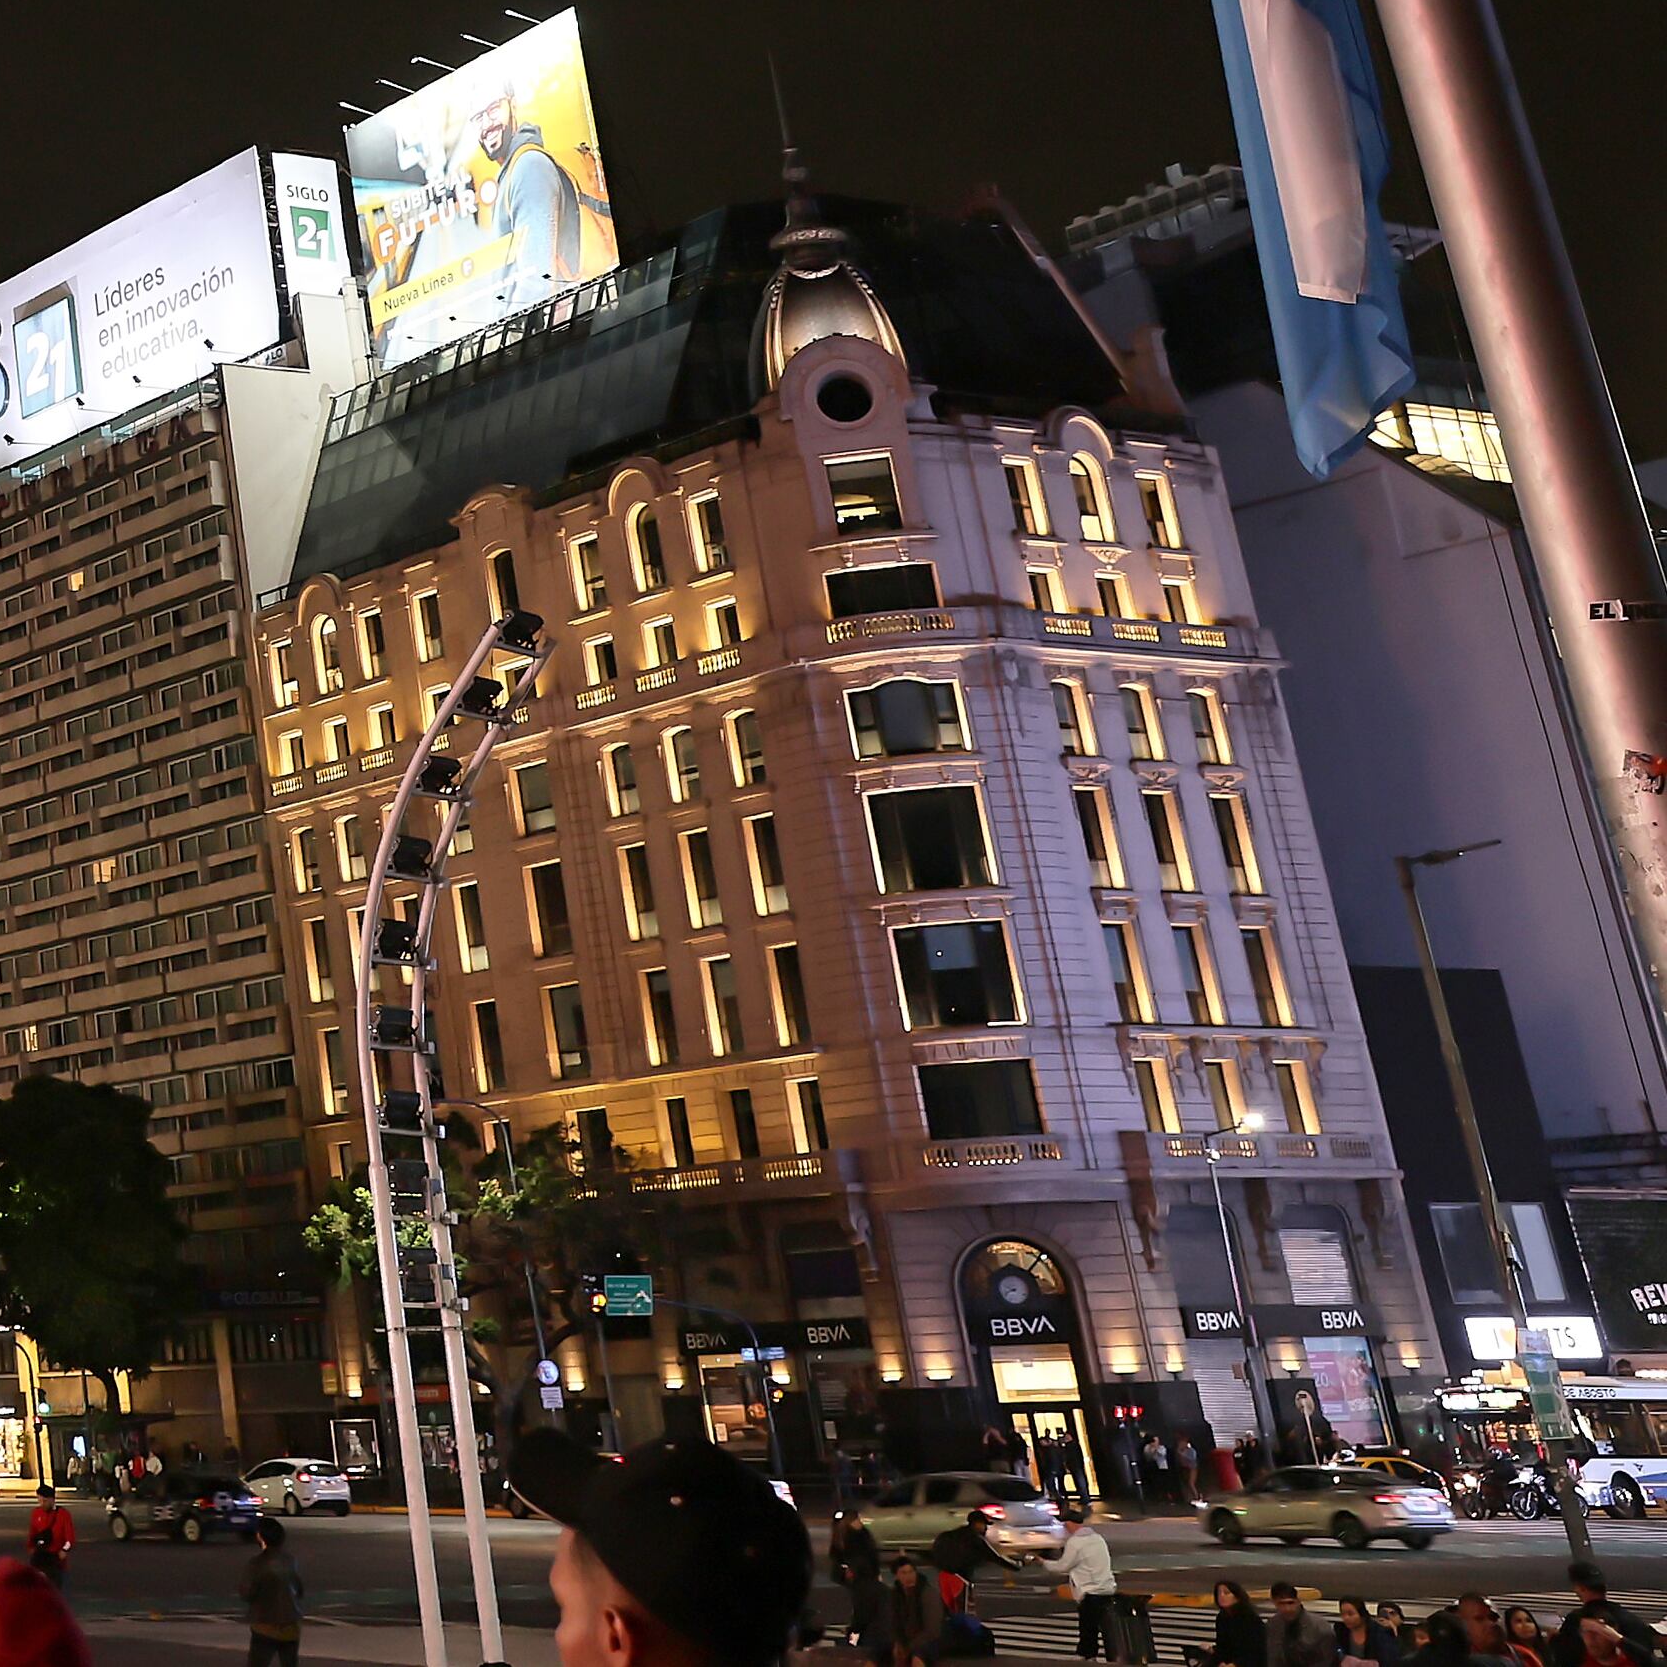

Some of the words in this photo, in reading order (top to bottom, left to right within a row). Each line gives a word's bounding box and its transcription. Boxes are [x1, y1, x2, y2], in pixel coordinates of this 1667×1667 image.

[286, 184, 329, 202] SIGLO
[296, 216, 328, 251] 21
[94, 265, 166, 317] Líderes
[383, 289, 419, 313] Nueva
[422, 271, 454, 303] Línea
[98, 317, 121, 347] en
[126, 265, 235, 335] innovación
[101, 317, 205, 379] educativa.
[25, 331, 70, 404] 21
[1589, 602, 1616, 620] EL
[990, 1315, 1055, 1336] BBVA
[1196, 1310, 1240, 1331] BBVA
[1321, 1310, 1364, 1330] BBVA
[686, 1332, 727, 1349] BBVA
[807, 1324, 851, 1344] BBVA
